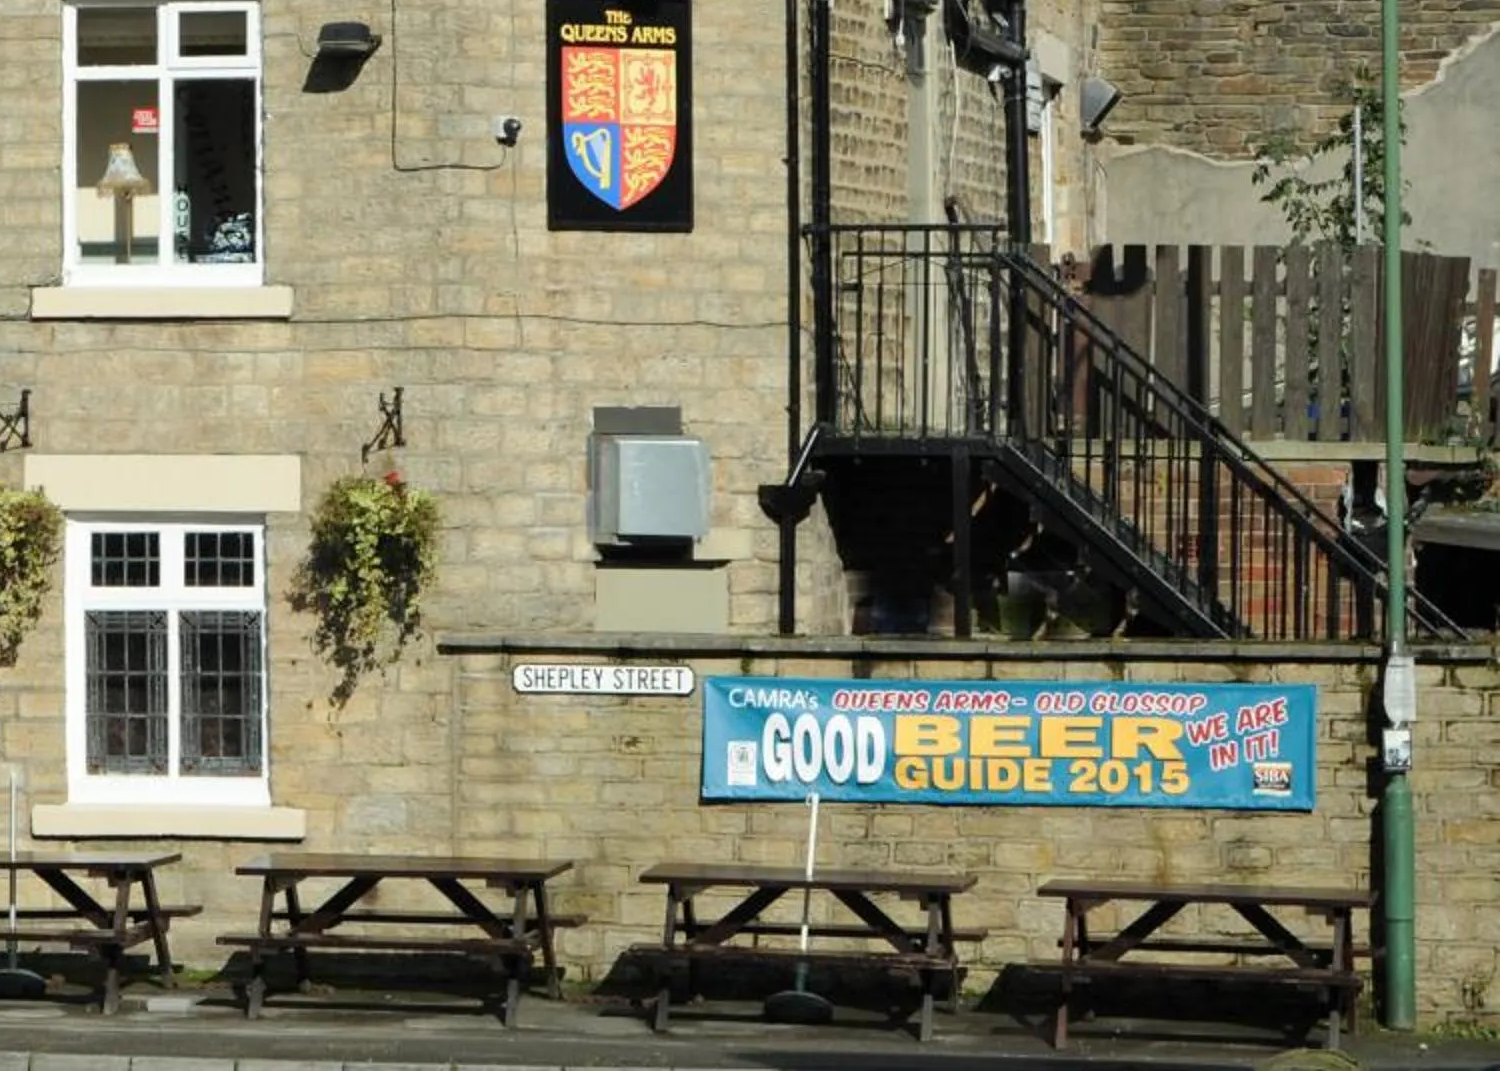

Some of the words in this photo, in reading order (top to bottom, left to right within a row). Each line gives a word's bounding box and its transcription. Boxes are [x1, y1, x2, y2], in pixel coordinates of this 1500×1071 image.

[605, 10, 632, 25] THE
[561, 25, 627, 43] QUEENS
[631, 26, 677, 44] ARMS
[523, 667, 603, 689] SHEPLEY
[613, 668, 684, 690] STREET
[728, 688, 819, 710] CAMRA's
[832, 690, 930, 711] QUEENS
[934, 691, 1010, 711] ARMS
[1035, 692, 1085, 714] OLD
[1090, 692, 1207, 715] GLOSSOP
[762, 712, 885, 784] GOOD
[894, 714, 1184, 760] BEER
[1186, 714, 1228, 745] WE
[1236, 698, 1288, 734] ARE
[895, 756, 1053, 792] GUIDE
[1068, 760, 1190, 796] 2015
[1210, 740, 1237, 770] IN
[1243, 729, 1279, 763] IT!
